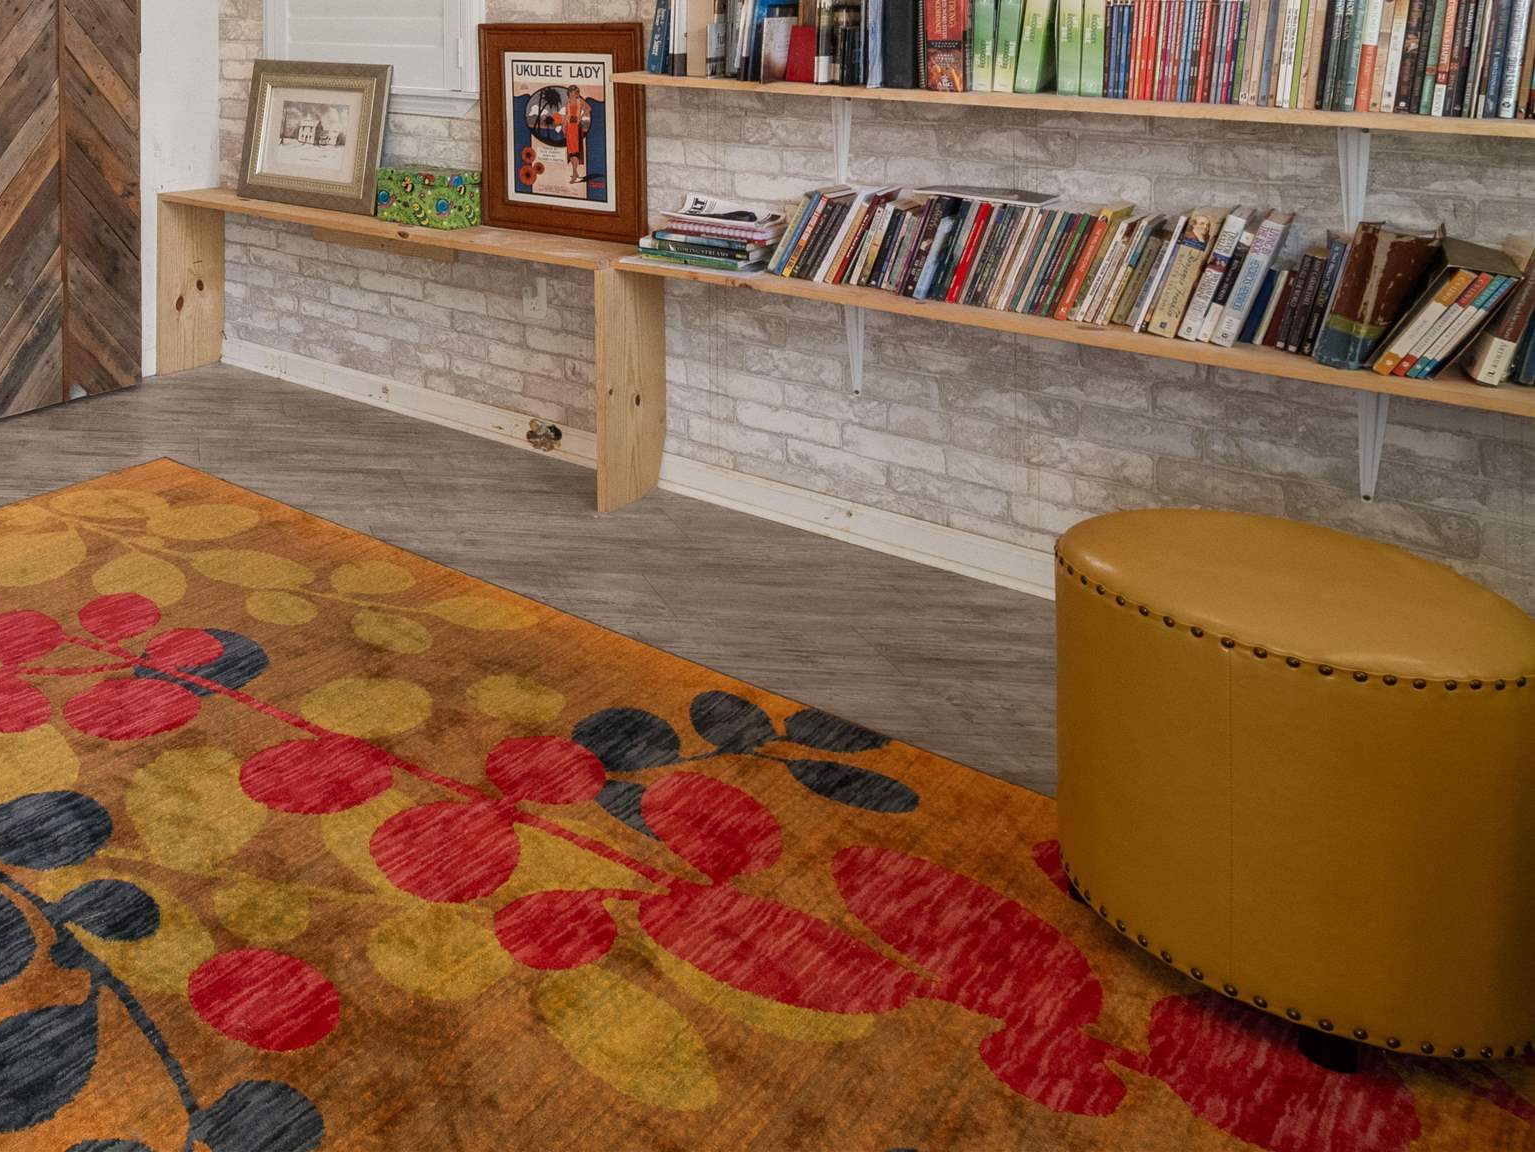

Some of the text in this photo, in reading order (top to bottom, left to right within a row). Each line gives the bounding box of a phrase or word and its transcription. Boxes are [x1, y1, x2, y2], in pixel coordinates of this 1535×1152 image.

[515, 64, 601, 80] UKULELE LADY
[1248, 223, 1270, 255] THE BOOK
[1263, 226, 1280, 249] LIVING
